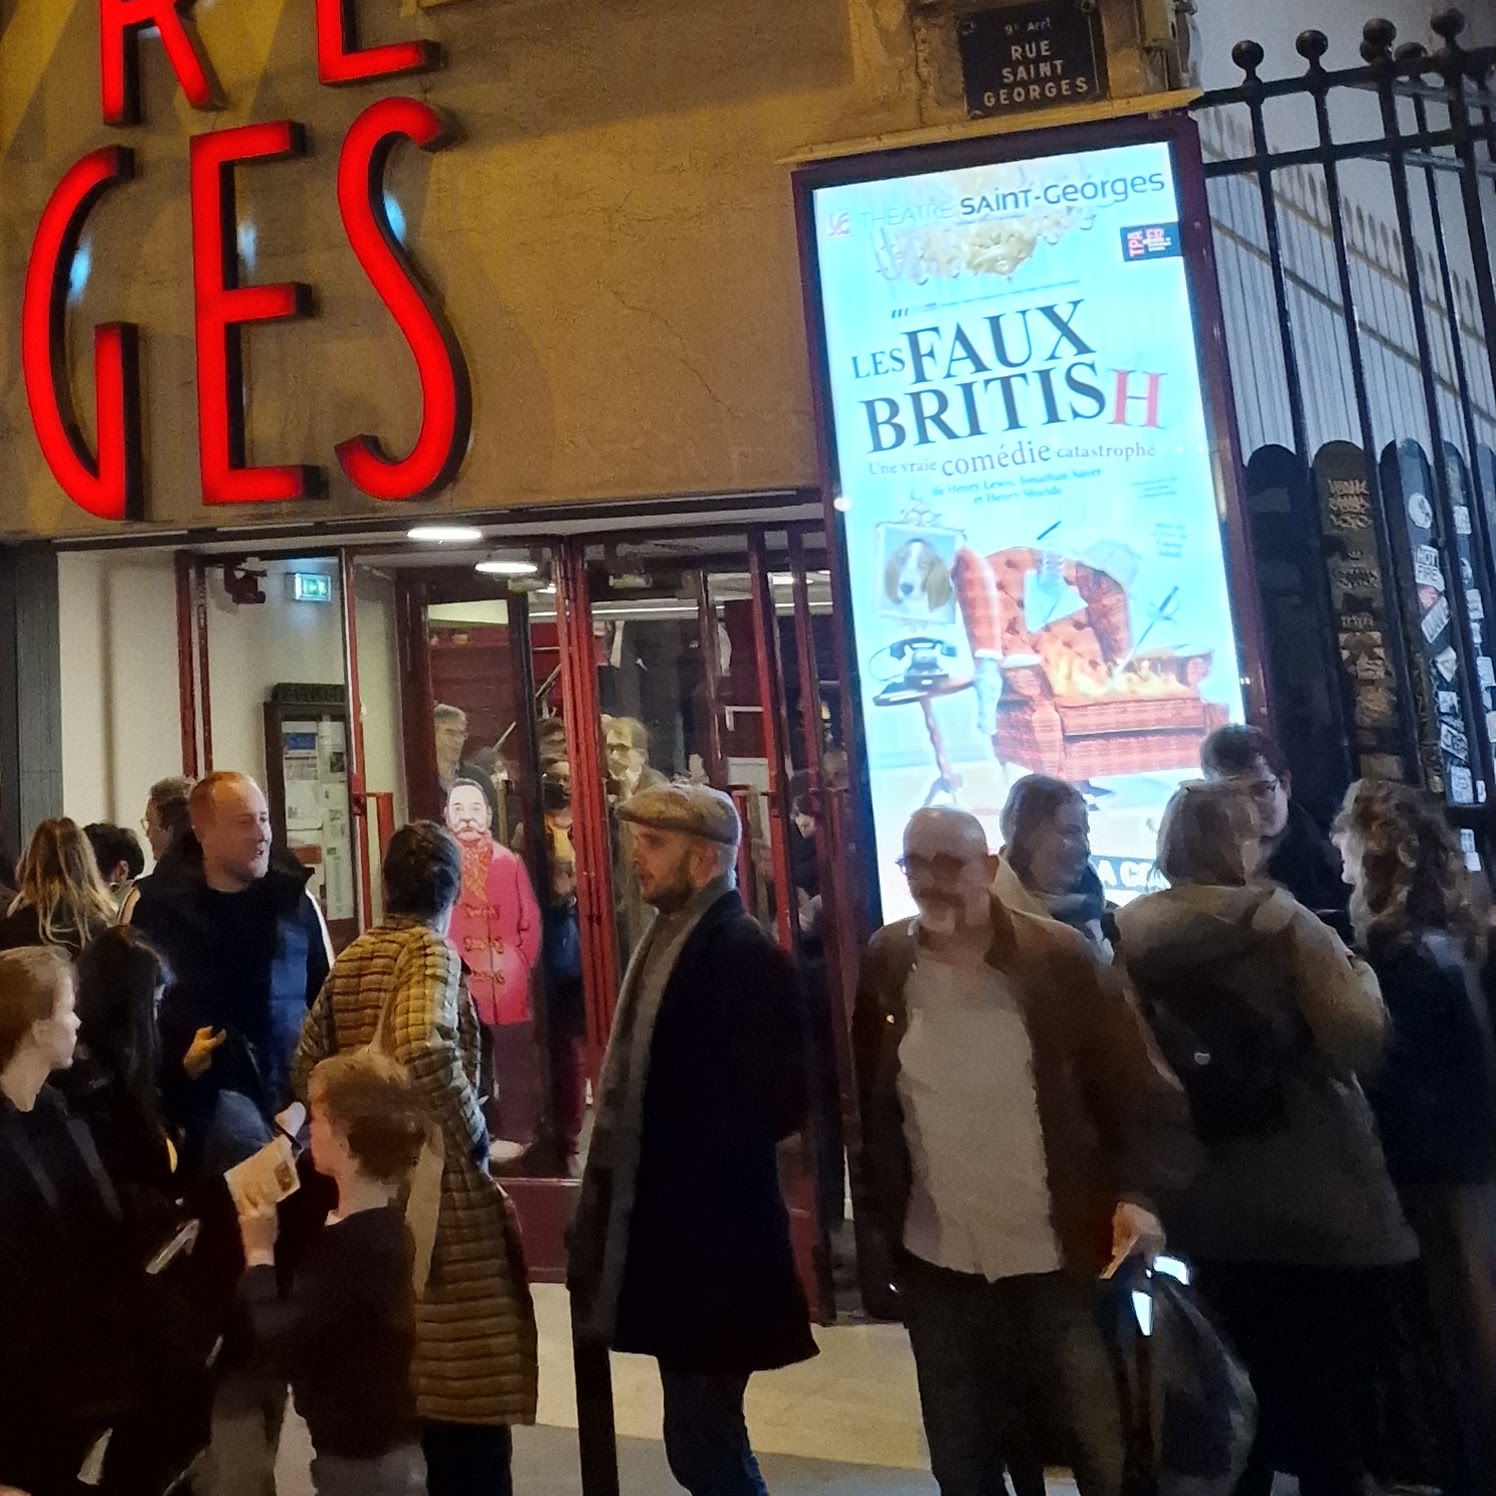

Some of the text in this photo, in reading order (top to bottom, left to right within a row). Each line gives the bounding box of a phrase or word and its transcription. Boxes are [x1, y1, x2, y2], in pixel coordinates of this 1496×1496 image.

[1011, 40, 1051, 61] RUE
[1002, 60, 1063, 83] SAINT
[984, 77, 1088, 107] GEORGES
[851, 348, 906, 380] LES
[900, 298, 1097, 385] FAUX
[858, 360, 1168, 454] BRITISH
[867, 461, 898, 476] Une
[901, 458, 937, 474] vraie
[941, 440, 1052, 478] comédie
[1056, 441, 1156, 462] catastrophe
